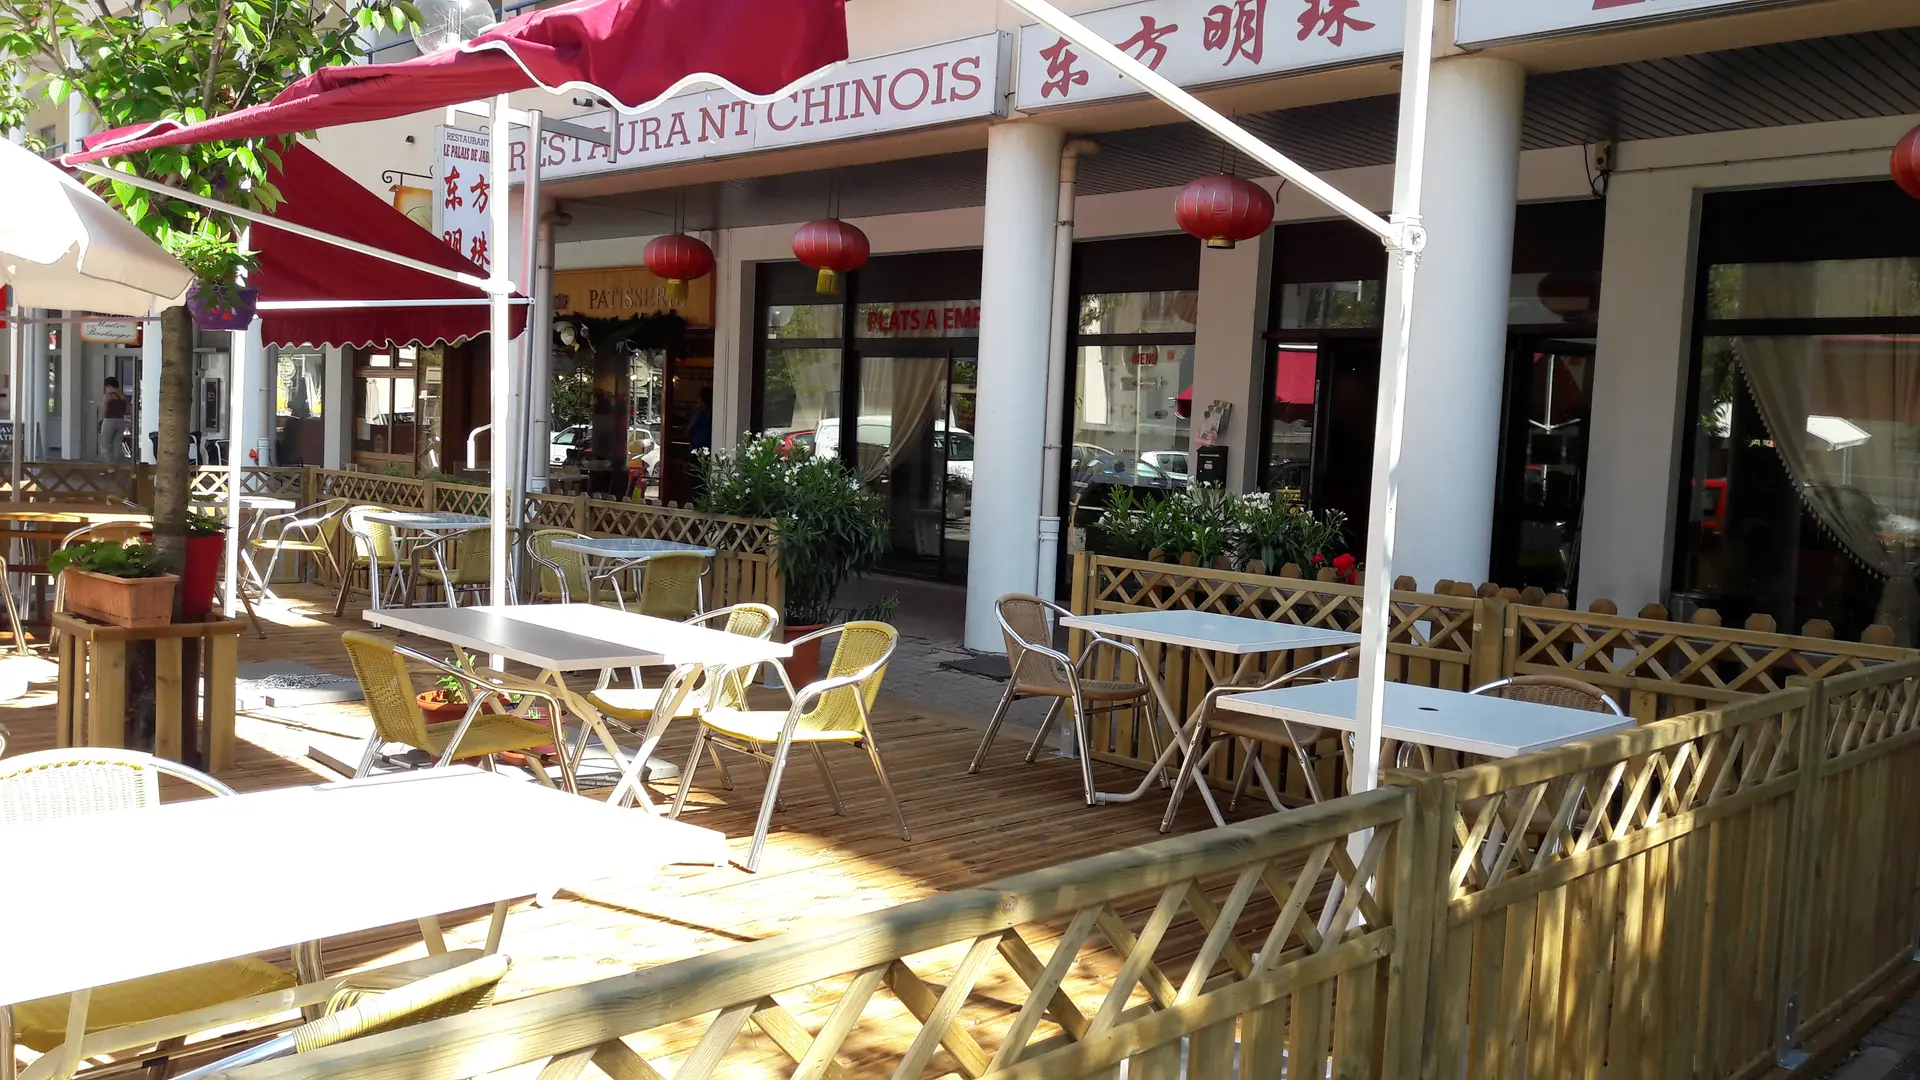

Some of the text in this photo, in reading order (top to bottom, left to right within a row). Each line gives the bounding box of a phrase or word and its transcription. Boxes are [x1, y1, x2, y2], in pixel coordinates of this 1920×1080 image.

[767, 56, 981, 131] CHINOIS
[446, 132, 490, 147] RESTAURANT
[443, 144, 490, 164] LE PALAIS DE JAD
[868, 309, 920, 332] PLATS
[925, 309, 938, 330] A
